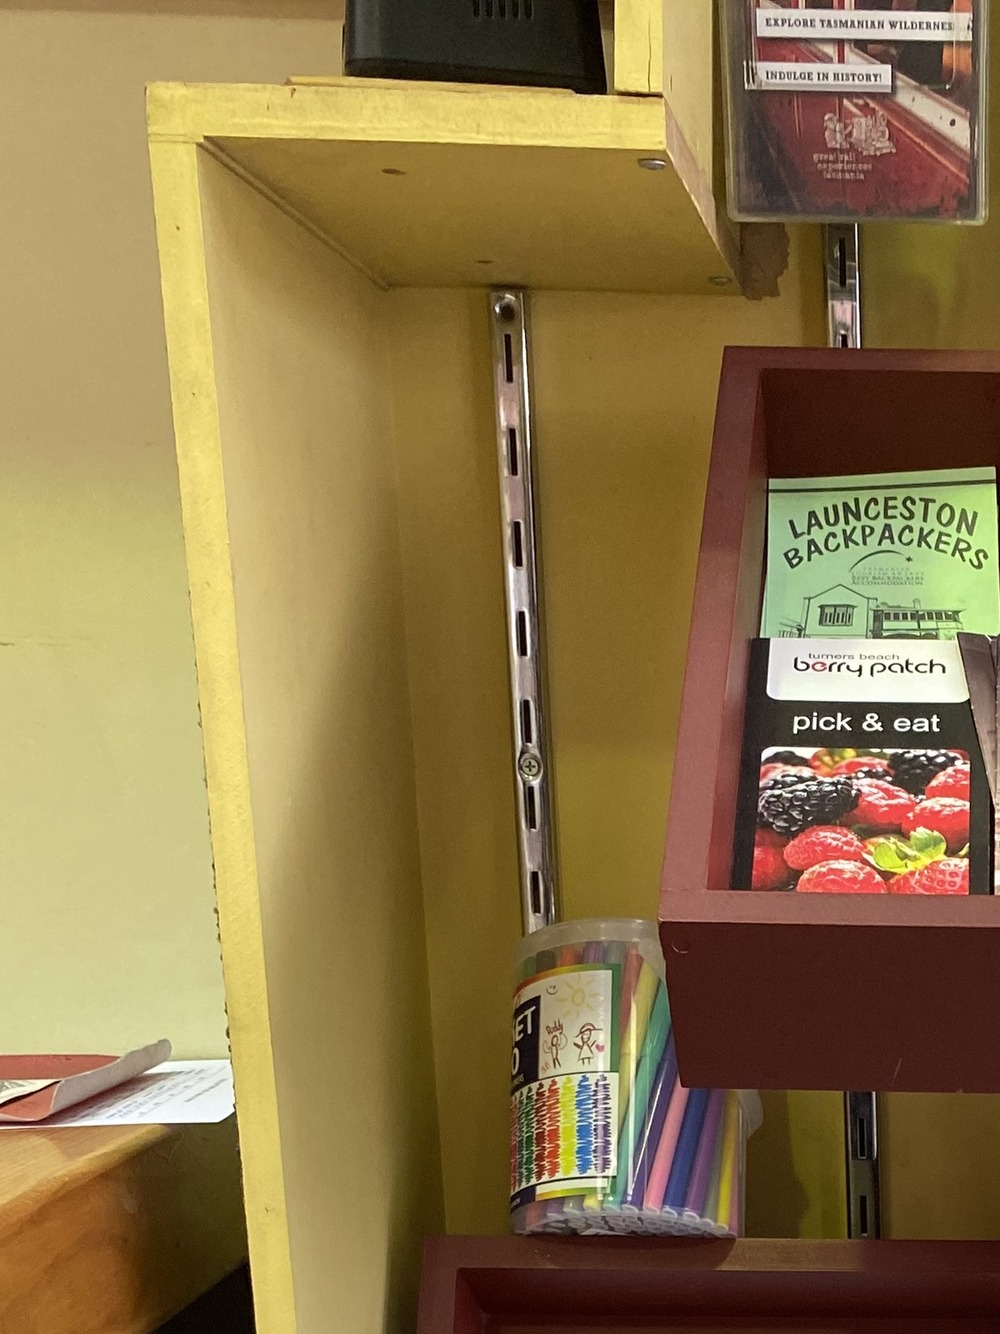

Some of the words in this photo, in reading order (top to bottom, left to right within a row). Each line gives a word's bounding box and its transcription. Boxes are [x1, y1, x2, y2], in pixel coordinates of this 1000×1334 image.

[765, 17, 816, 28] EXPLORE
[820, 19, 885, 29] TASMANIAN
[765, 70, 814, 82] INDULGE
[817, 72, 829, 82] IN
[833, 72, 882, 83] HISTORY!
[788, 496, 978, 540] LAUNCESTON
[783, 523, 989, 570] BACKPACKERS
[793, 656, 863, 677] berry
[870, 658, 946, 677] patch
[793, 712, 852, 734] pick
[862, 713, 883, 732] &
[893, 714, 941, 732] eat
